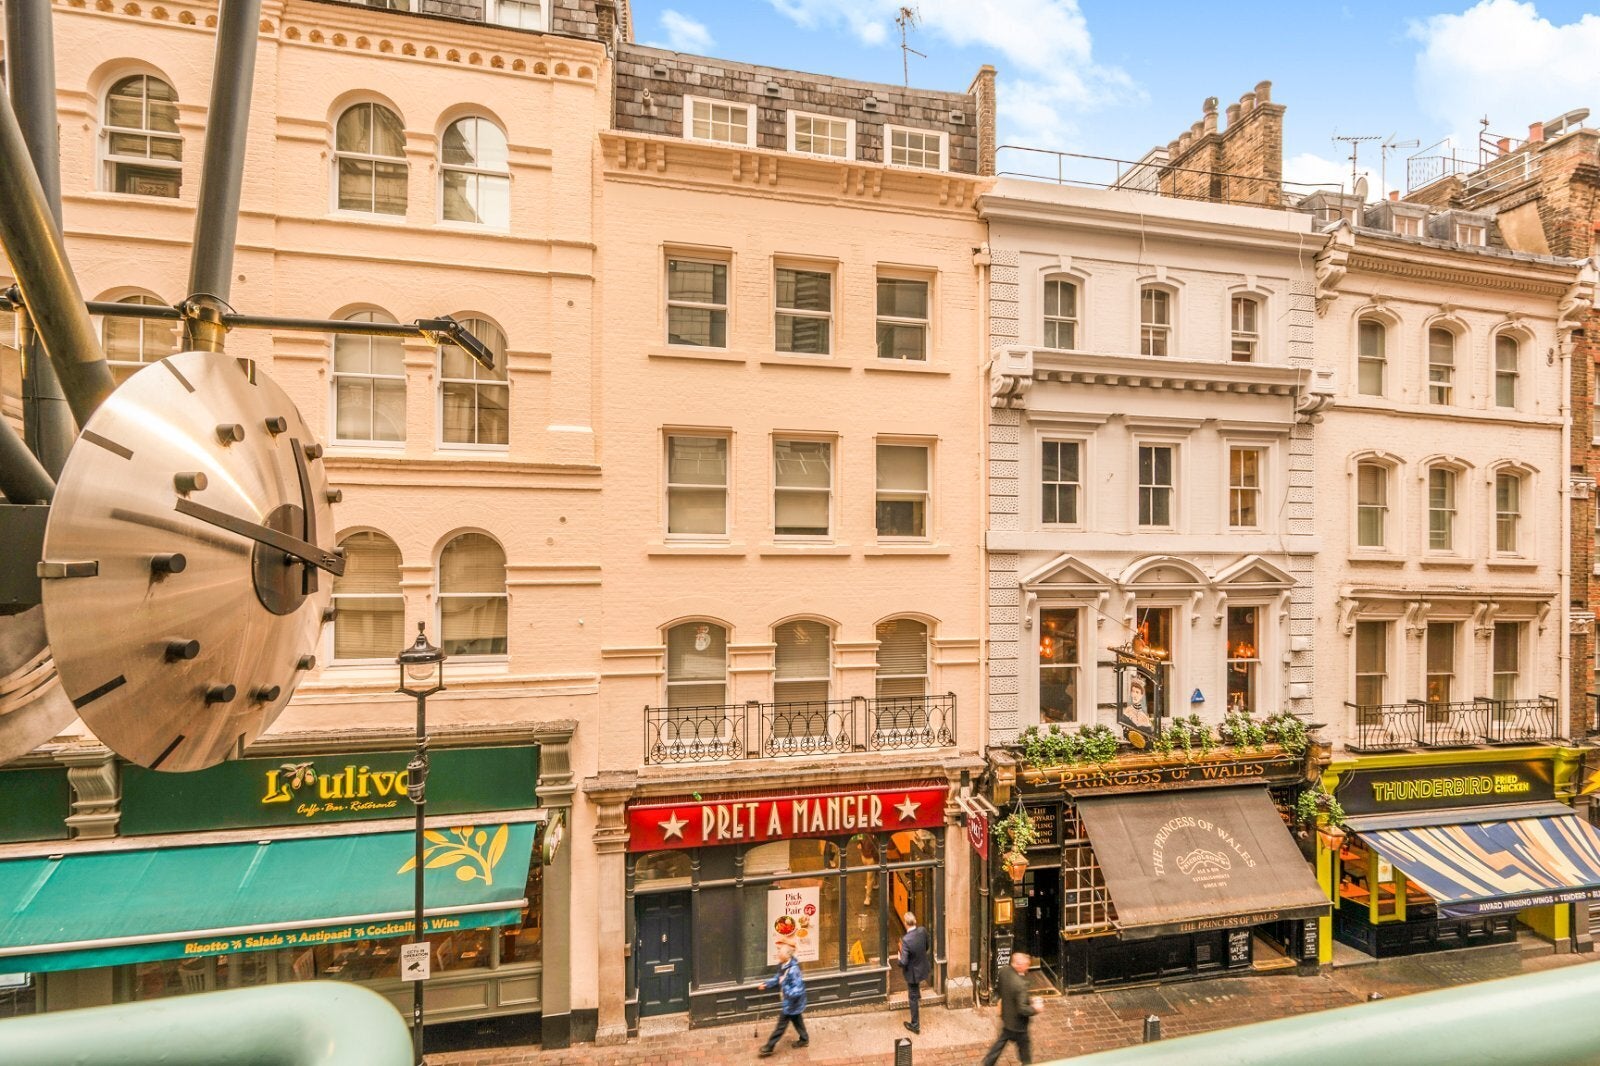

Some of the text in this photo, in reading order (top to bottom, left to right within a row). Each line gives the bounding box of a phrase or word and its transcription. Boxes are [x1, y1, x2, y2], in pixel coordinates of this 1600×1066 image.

[1058, 767, 1162, 789] PRINCESS
[1201, 761, 1265, 780] WALES
[1494, 775, 1518, 785] FRIED
[1372, 776, 1493, 801] THUNDERBIRD
[1494, 782, 1530, 793] CHICKEN
[324, 802, 344, 812] Bar
[350, 800, 398, 811] Ristorante
[702, 795, 883, 841] PRET A MANGER
[1153, 816, 1257, 876] THE PRINCESS OF WALES
[785, 892, 802, 901] Pick
[1479, 901, 1503, 911] AWARD
[1504, 899, 1531, 908] WINNING
[1532, 896, 1554, 904] WINGS
[1560, 892, 1586, 902] TENDERS
[785, 907, 802, 915] Pair
[1180, 912, 1279, 931] THE PRINCESS OF WALES
[184, 918, 460, 954] Risotto Salads Antipasti Cocktails Wine
